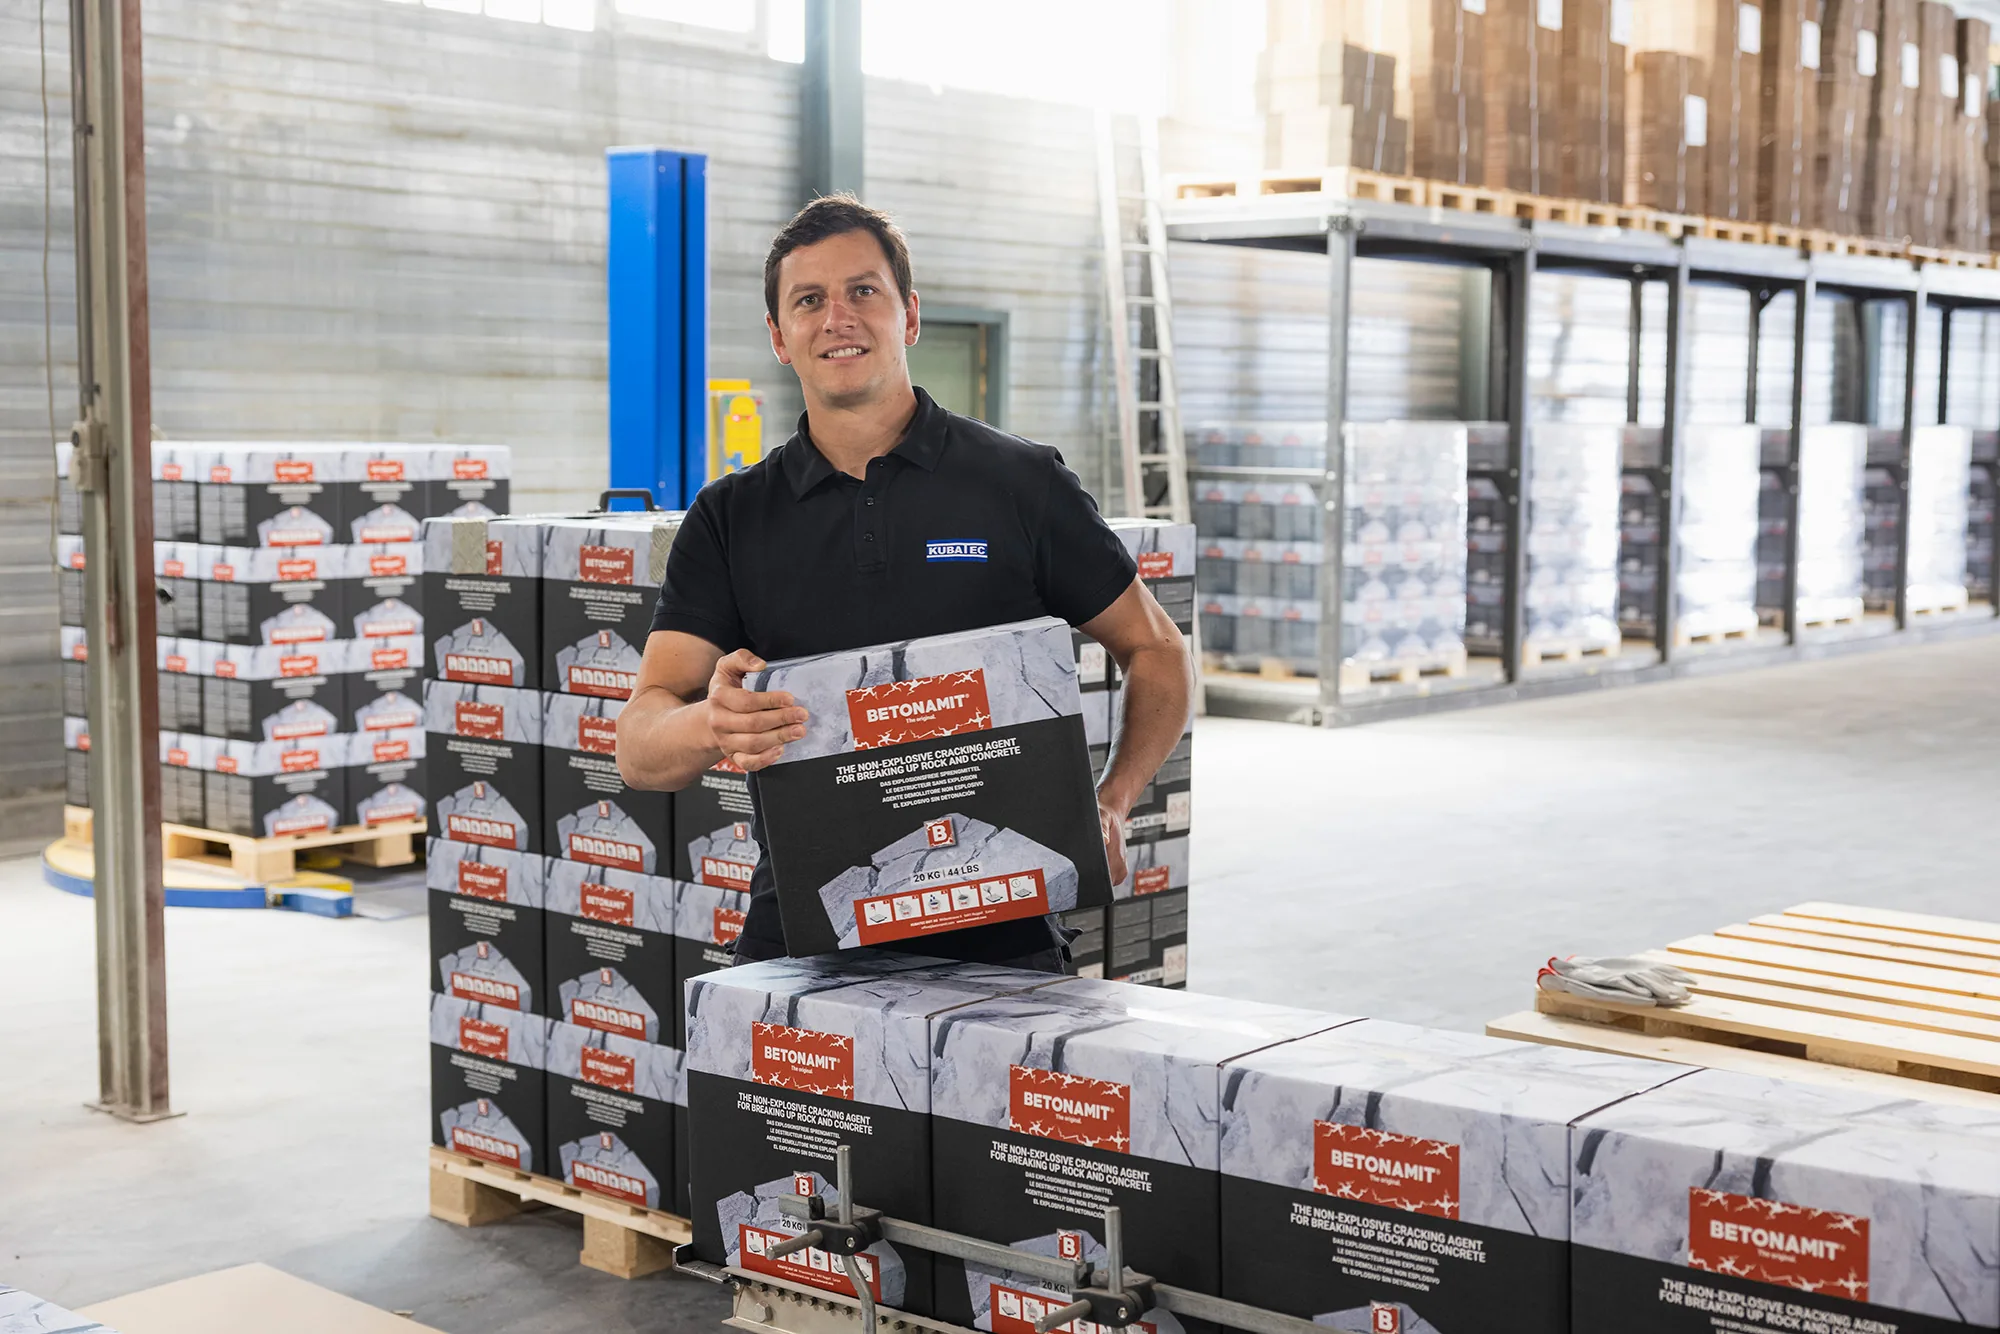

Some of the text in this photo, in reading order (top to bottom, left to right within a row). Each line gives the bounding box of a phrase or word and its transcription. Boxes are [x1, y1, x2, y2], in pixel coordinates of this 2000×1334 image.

[929, 545, 985, 555] KUBATEC
[835, 745, 1021, 784] FOR BREAKING UP ROCK AND CONCRETE
[836, 737, 1017, 775] THE NON-EXPLOSIVE CRACKING AGENT
[931, 778, 947, 786] SANS
[947, 773, 977, 783] EXPLOSION
[882, 794, 903, 802] AGENTE
[954, 780, 984, 790] ESPLOSIVO
[900, 797, 930, 807] EXPLOSIVO
[932, 825, 948, 842] B
[913, 873, 925, 882] 20
[927, 870, 940, 880] KG
[947, 867, 959, 876] 44
[960, 863, 979, 874] LBS
[737, 1100, 872, 1135] FOR BREAKING UP ROCK AND CONCRETE
[738, 1092, 870, 1125] THE NON-EXPLOSIVE CRACKING AGENT
[990, 1150, 1151, 1192] FOR BREAKING UP ROCK AND CONCRETE
[992, 1140, 1149, 1181] THE NON-EXPLOSIVE CRACKING AGENT
[799, 1176, 811, 1196] B
[1370, 1174, 1379, 1182] The
[782, 1219, 802, 1230] 20 KG
[1292, 1203, 1483, 1251] THE NON-EXPLOSIVE CRACKING AGENT
[1063, 1237, 1075, 1255] B
[1290, 1213, 1485, 1262] FOR BREAKING UP ROCK AND CONCRETE
[1042, 1280, 1066, 1293] 20 KG
[1659, 1289, 1682, 1304] FOR
[1684, 1294, 1744, 1317] BREAKING
[1746, 1307, 1763, 1321] UP
[1766, 1311, 1800, 1329] ROCK
[1802, 1319, 1829, 1334] AND
[1661, 1278, 1685, 1293] THE
[1688, 1283, 1784, 1313] NON-EXPLOSIVE
[1786, 1303, 1850, 1327] CRACKING
[1378, 1310, 1393, 1331] B
